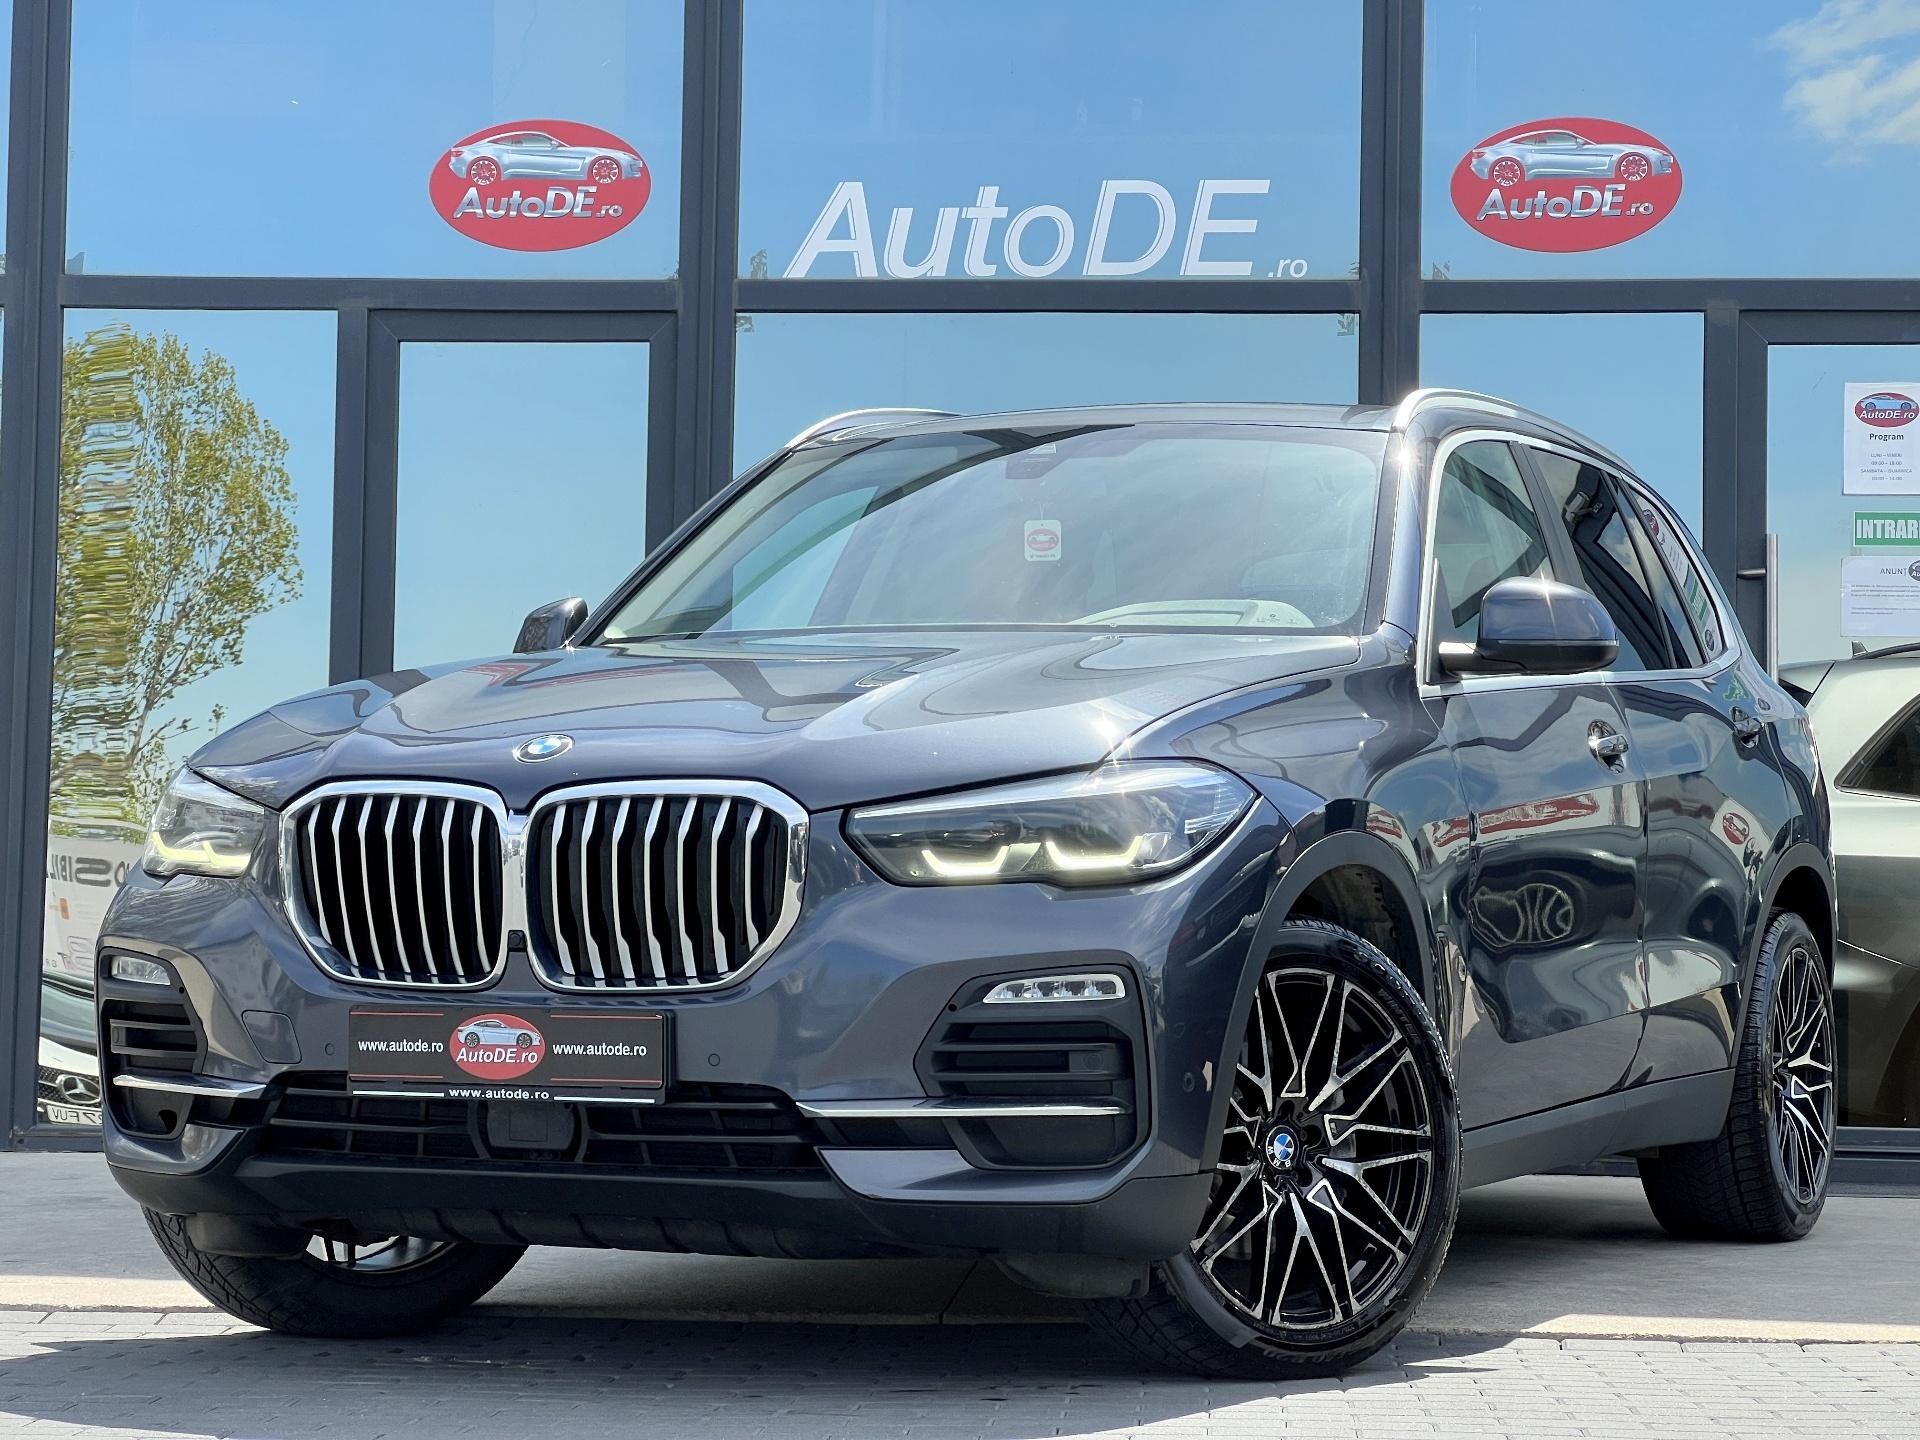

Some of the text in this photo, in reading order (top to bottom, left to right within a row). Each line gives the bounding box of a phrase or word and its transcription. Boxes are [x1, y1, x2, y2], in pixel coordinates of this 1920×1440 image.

[1860, 410, 1915, 419] AutoDE.ro
[1869, 433, 1904, 441] Program
[1856, 519, 1920, 539] INTRAR
[358, 1038, 444, 1054] www.autode.ro
[552, 1041, 647, 1057] www.autode.ro
[455, 1047, 539, 1065] AutoDE.ro
[449, 1087, 550, 1100] www.autode.ro
